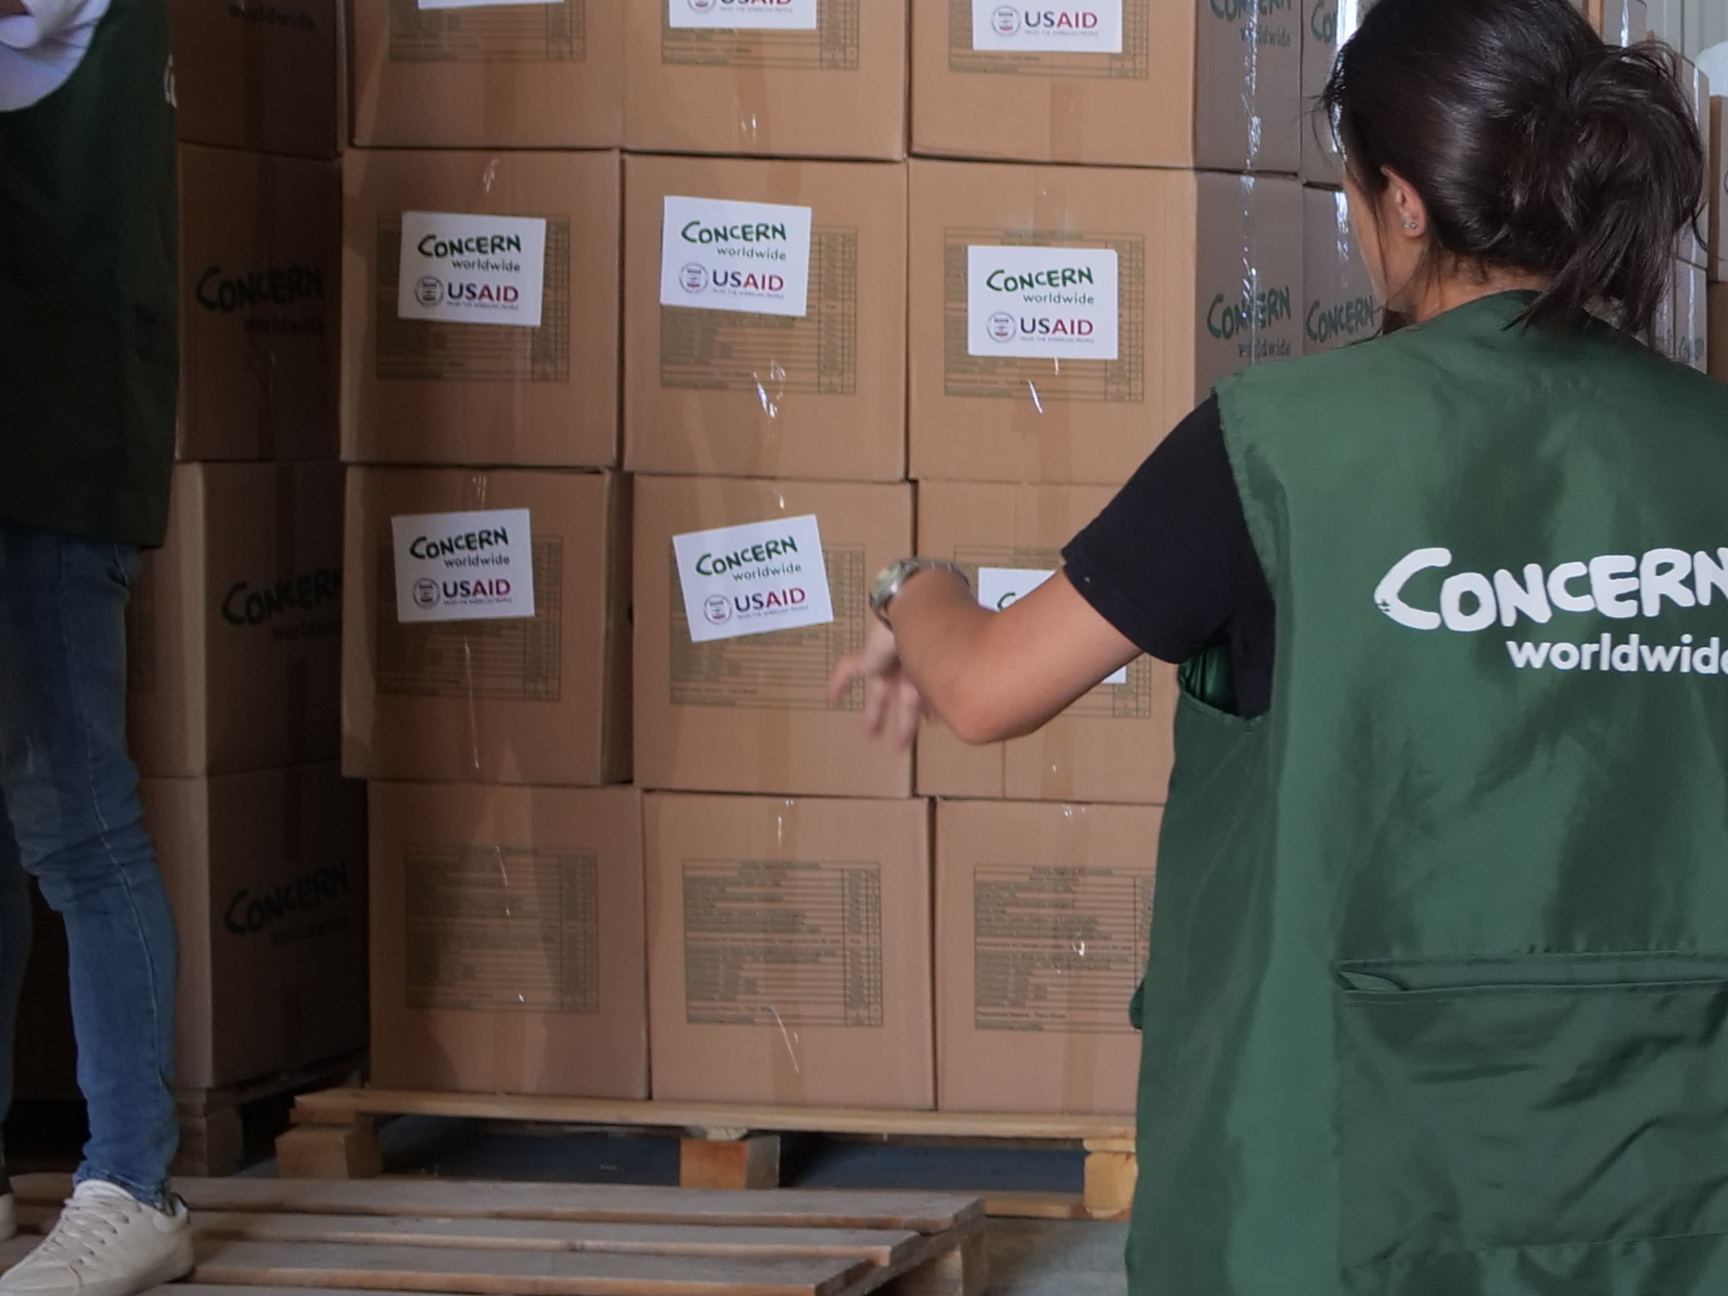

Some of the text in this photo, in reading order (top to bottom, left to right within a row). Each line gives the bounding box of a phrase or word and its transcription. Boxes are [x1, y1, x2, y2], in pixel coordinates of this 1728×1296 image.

[1025, 11, 1098, 29] USAID
[681, 220, 787, 244] CONCERN
[417, 233, 522, 258] CONCERN
[717, 245, 786, 261] worldwide
[452, 258, 521, 273] worldwide
[712, 269, 784, 292] USAID
[986, 266, 1094, 292] CONCERN
[447, 281, 519, 303] USAID
[1023, 291, 1094, 305] worldwide
[1020, 317, 1094, 336] USAID
[409, 526, 509, 559] CONCERN
[444, 553, 510, 569] worldwide
[695, 535, 798, 576] CONCERN
[732, 562, 802, 582] worldwide
[442, 578, 511, 598] USAID
[734, 587, 806, 612] USAID
